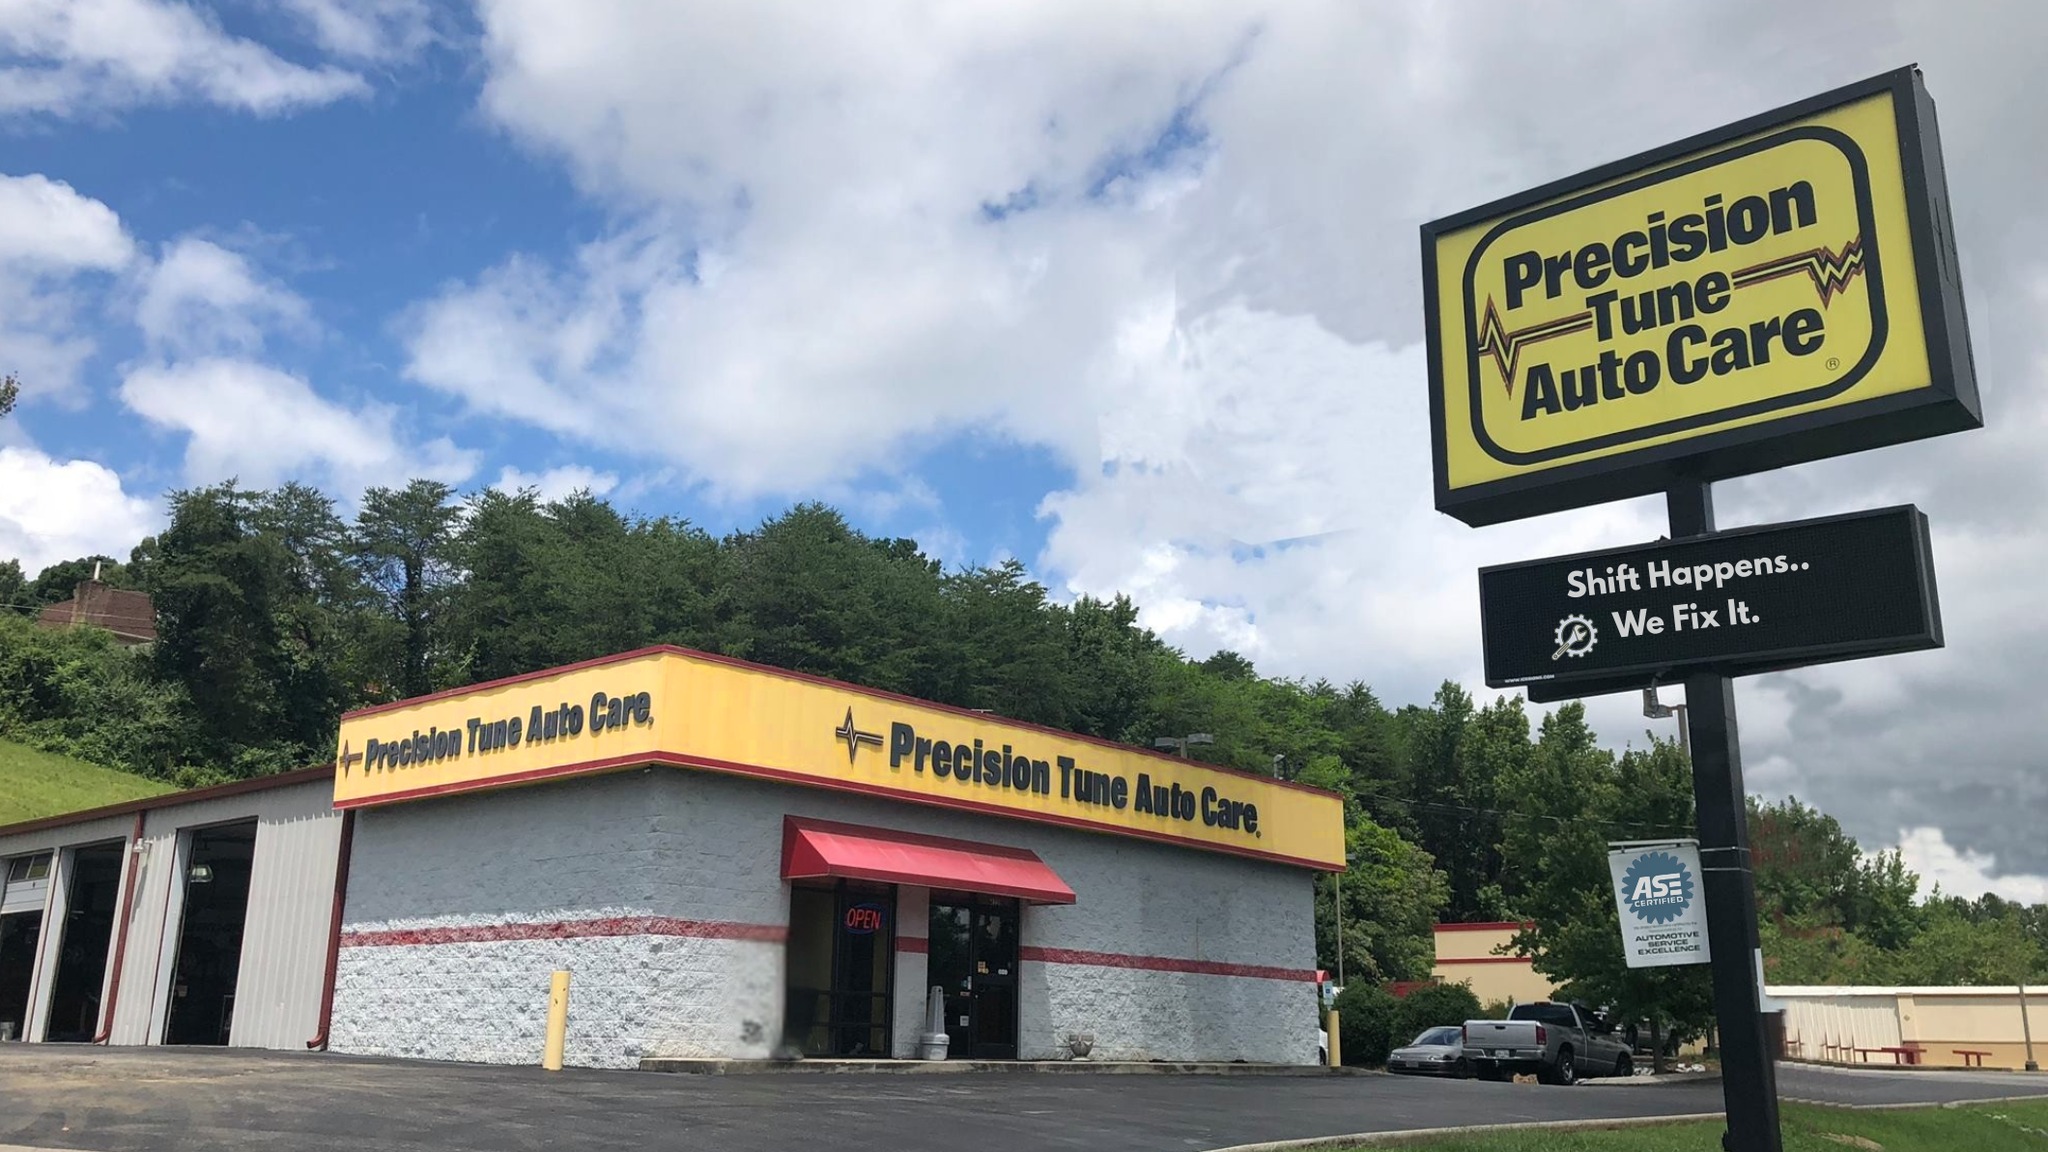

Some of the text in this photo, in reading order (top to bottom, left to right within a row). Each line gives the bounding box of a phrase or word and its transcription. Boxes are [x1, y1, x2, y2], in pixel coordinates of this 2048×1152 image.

[1504, 180, 1816, 311] Precision
[1586, 270, 1732, 342] Tune
[1566, 554, 1810, 598] Shift Happens..
[1611, 598, 1760, 639] We Fix It.
[365, 691, 651, 771] Precision Tune Auto Care
[890, 721, 1259, 832] Precision Tune Auto Care
[1632, 873, 1683, 900] ASE
[1634, 896, 1683, 907] CERTIFIED
[846, 907, 881, 930] OPEN
[1635, 931, 1699, 941] AUTOMOTIVE
[1638, 945, 1700, 955] EXCELLENCE
[1648, 939, 1688, 948] SERVICE
